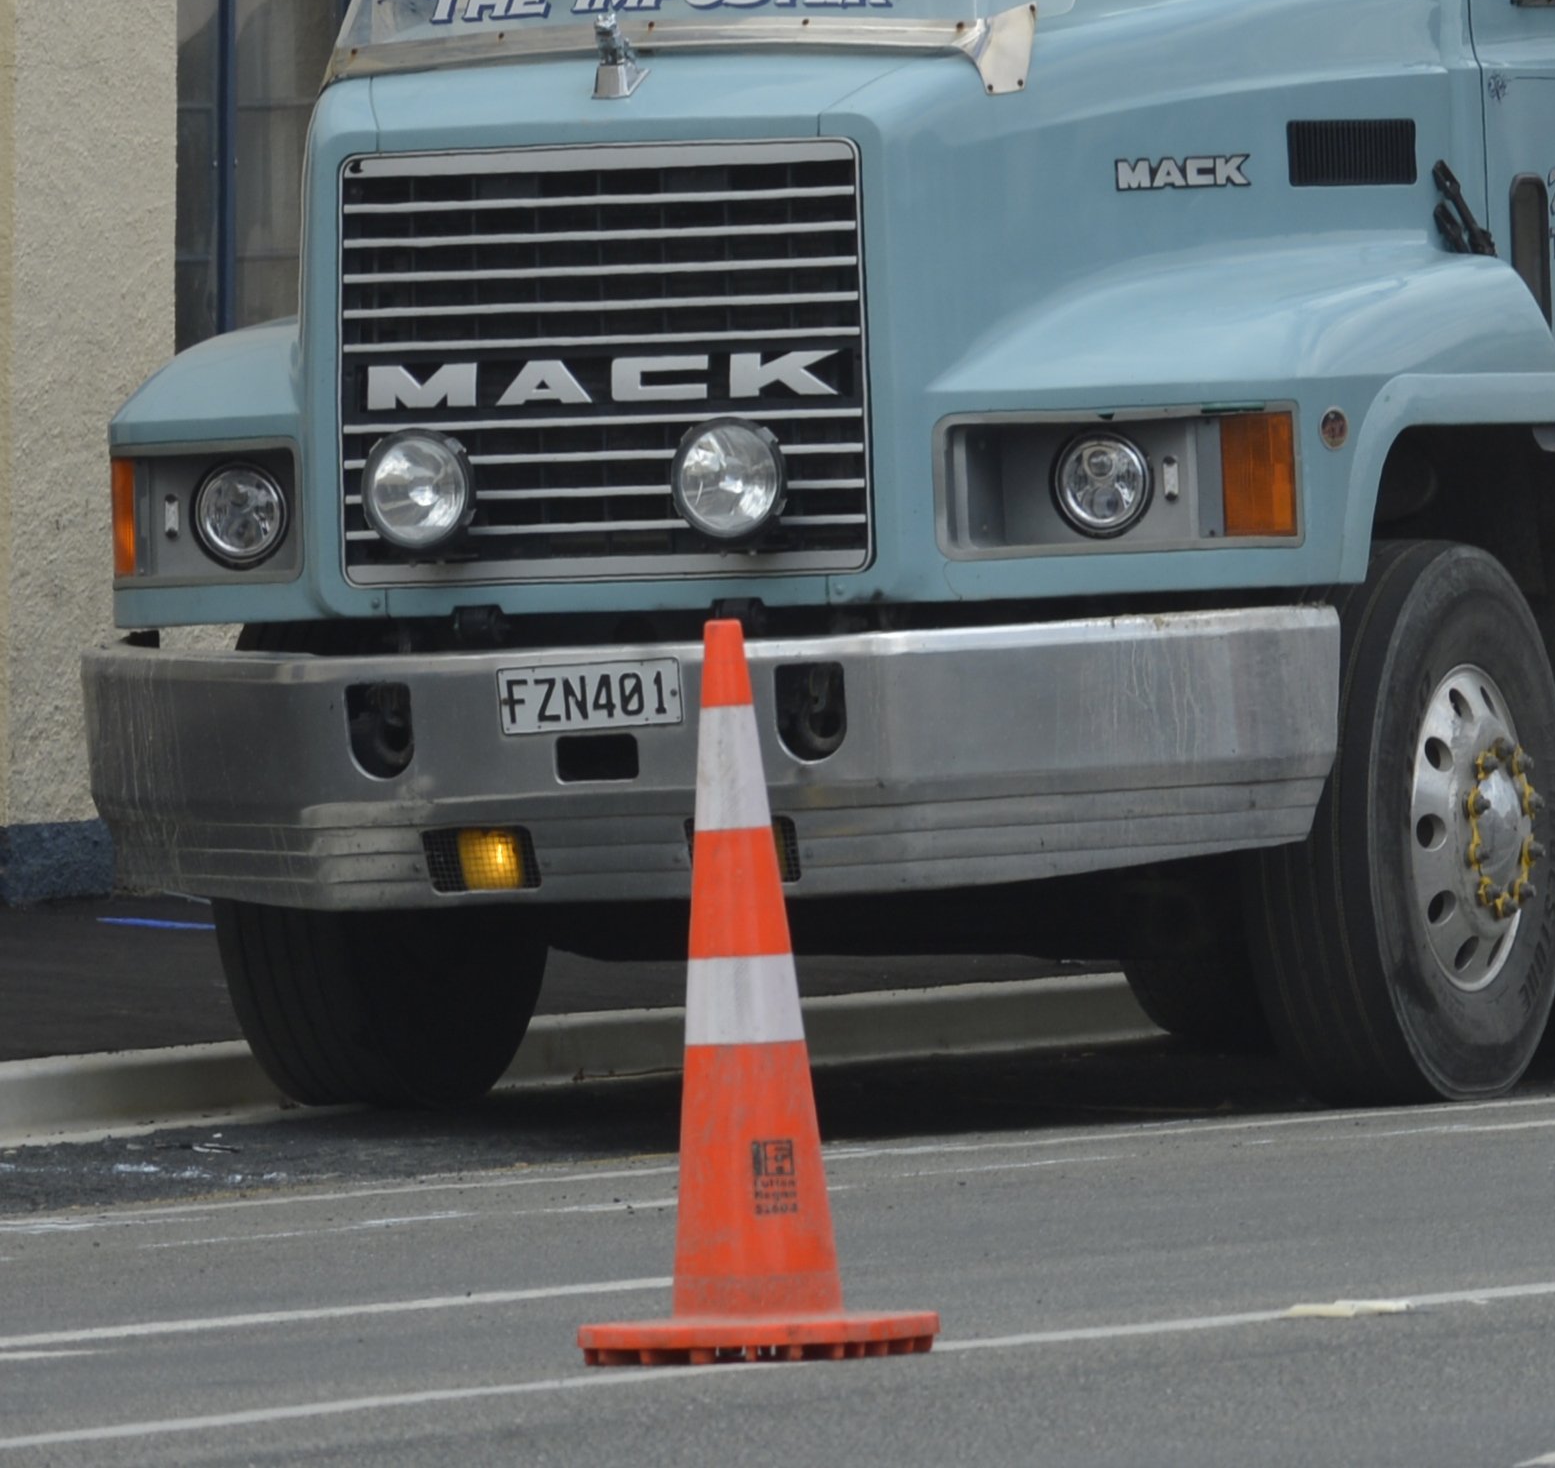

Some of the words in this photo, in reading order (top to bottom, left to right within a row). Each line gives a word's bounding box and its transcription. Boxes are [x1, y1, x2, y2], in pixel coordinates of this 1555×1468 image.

[1114, 154, 1252, 192] MACK
[366, 349, 842, 411] MACK
[505, 669, 667, 725] FZN401
